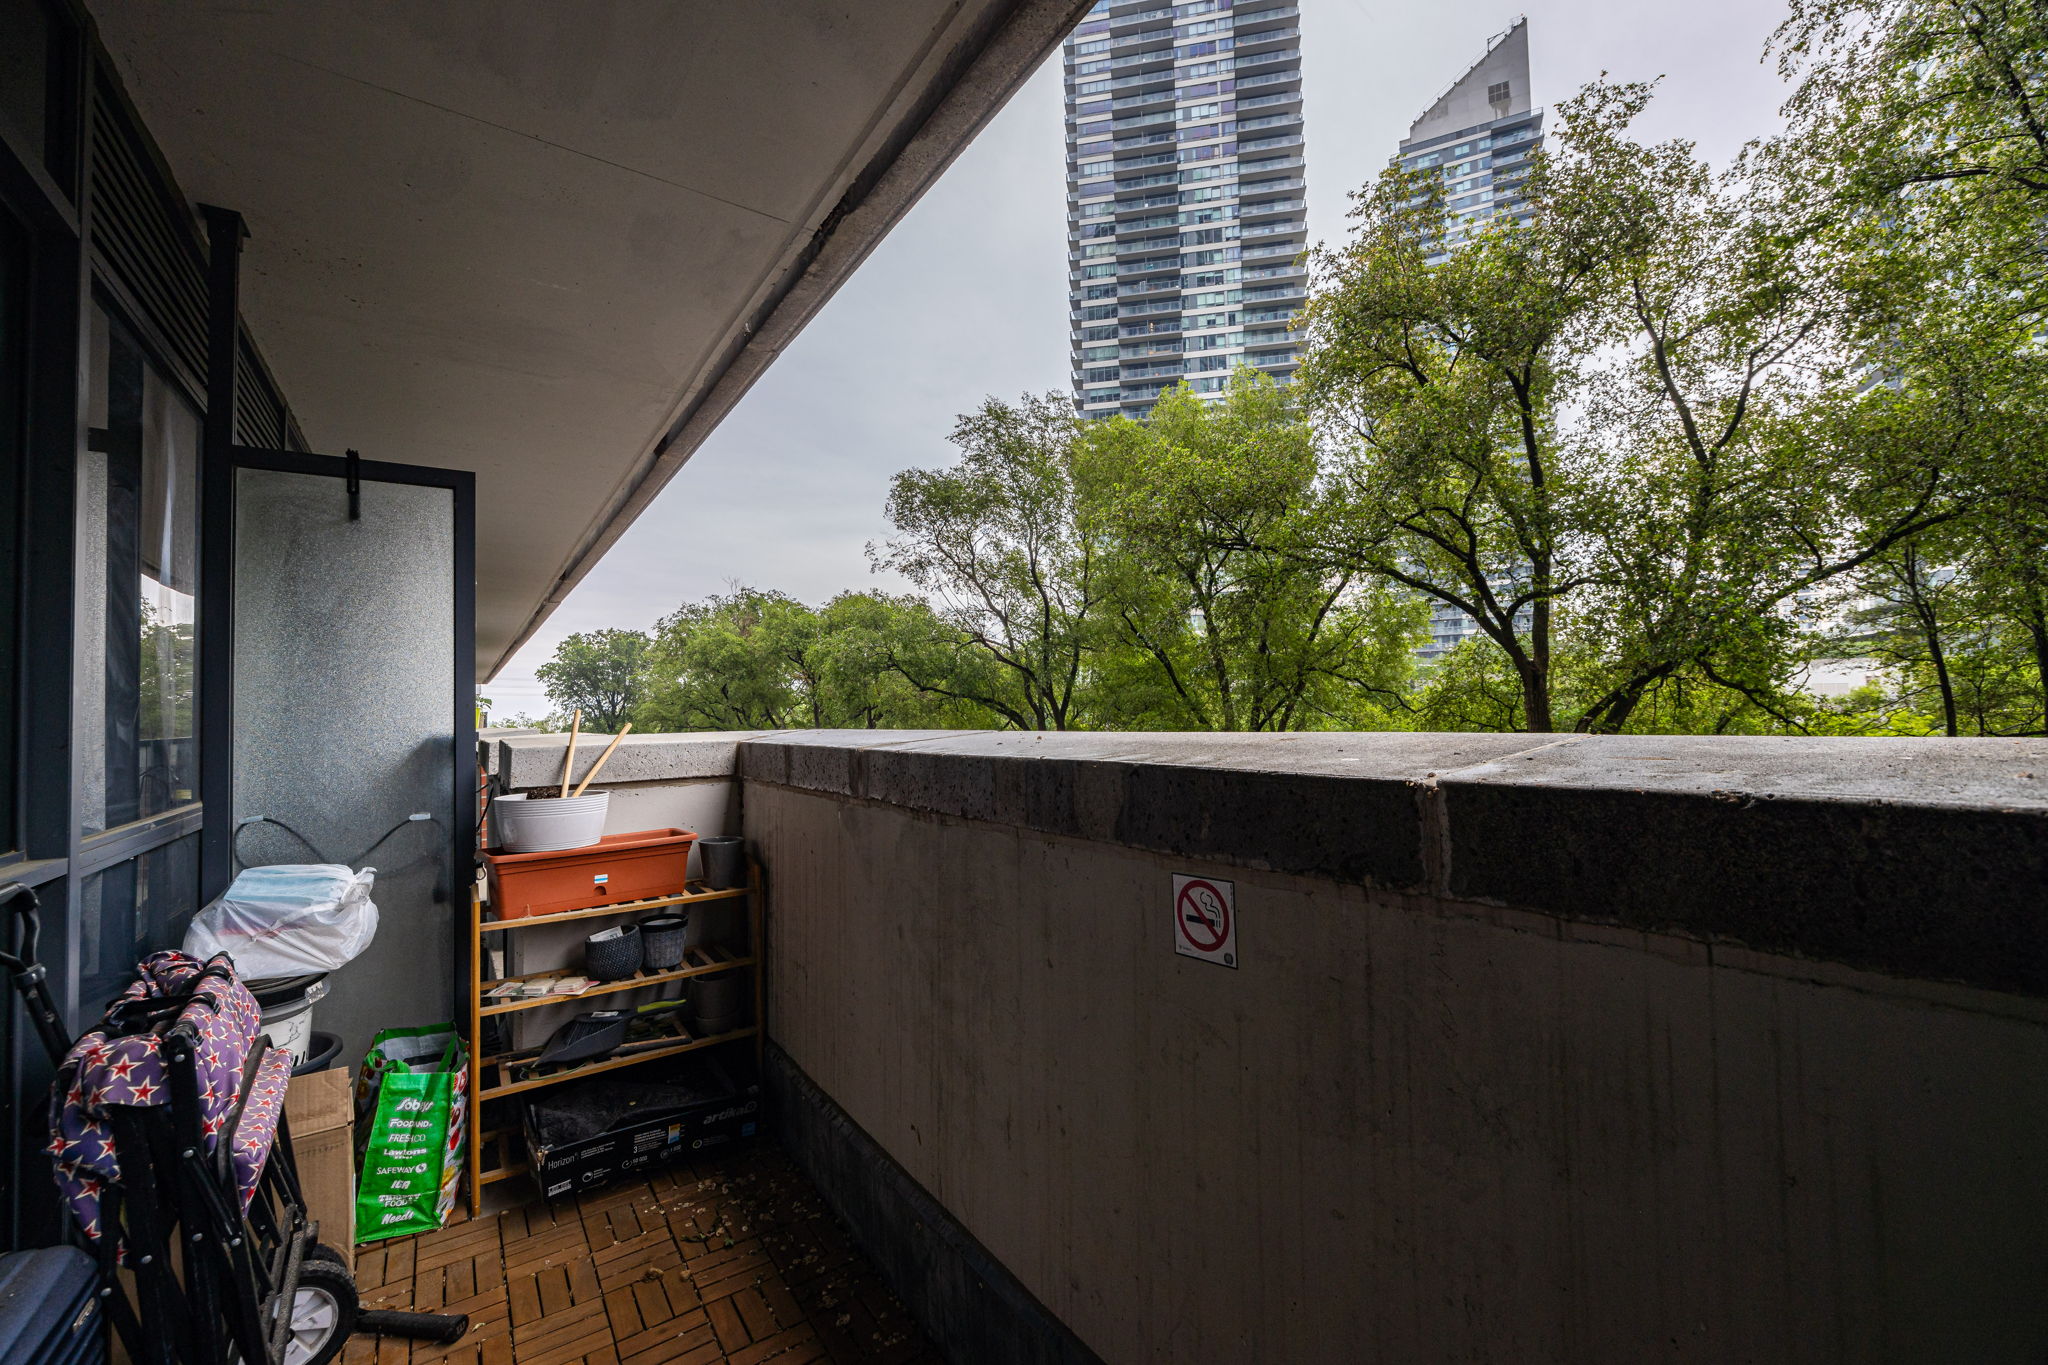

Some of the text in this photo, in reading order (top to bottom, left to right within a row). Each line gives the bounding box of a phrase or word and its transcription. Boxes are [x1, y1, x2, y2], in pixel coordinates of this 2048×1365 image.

[376, 1166, 415, 1175] SAFEWAY
[547, 1155, 575, 1171] Horizon
[381, 1209, 415, 1225] Needs
